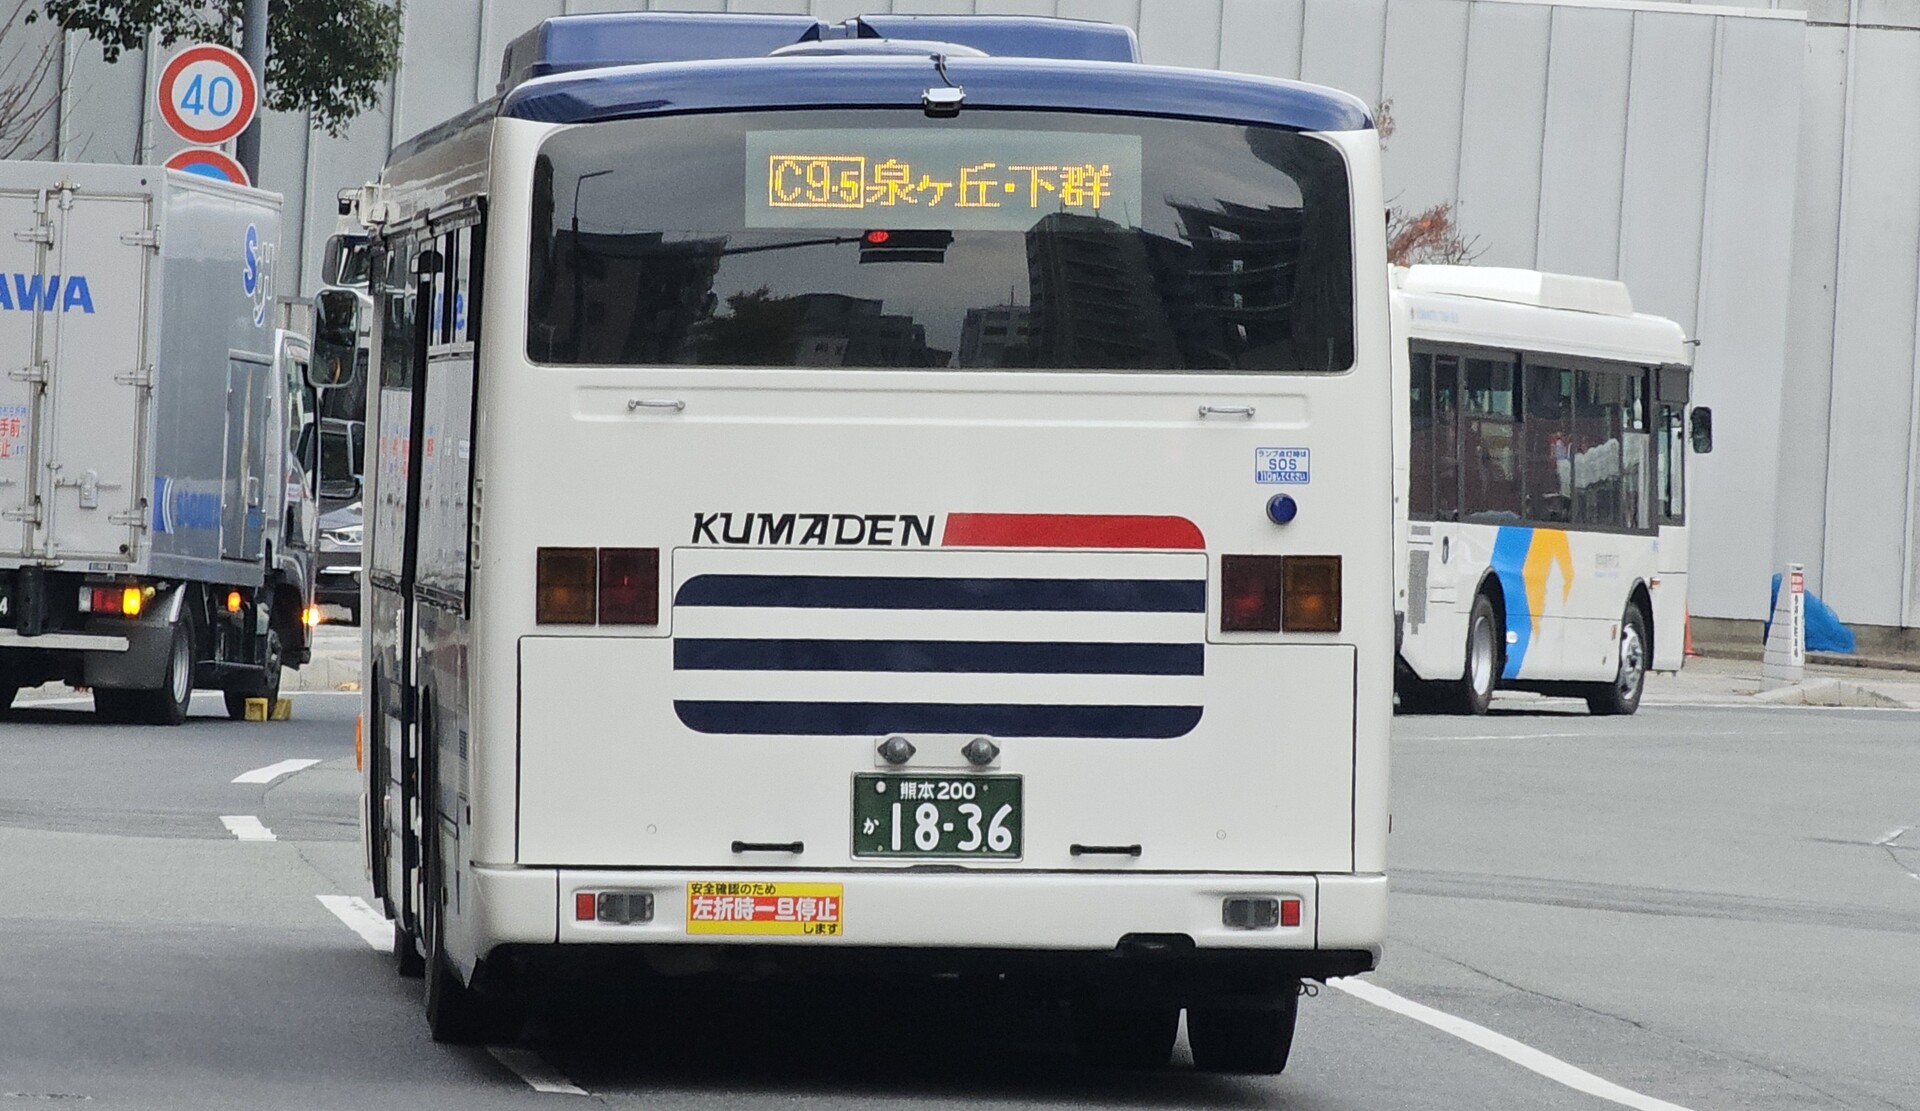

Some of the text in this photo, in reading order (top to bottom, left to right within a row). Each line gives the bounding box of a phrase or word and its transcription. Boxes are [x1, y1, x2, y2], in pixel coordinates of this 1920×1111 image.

[181, 74, 233, 117] 40
[1268, 458, 1297, 471] SOS
[691, 512, 936, 547] KUMADEN
[891, 802, 1013, 852] 18-36
[691, 883, 776, 895] 安全確認のため
[692, 895, 838, 922] 左折時一旦停止
[803, 923, 838, 934] します
